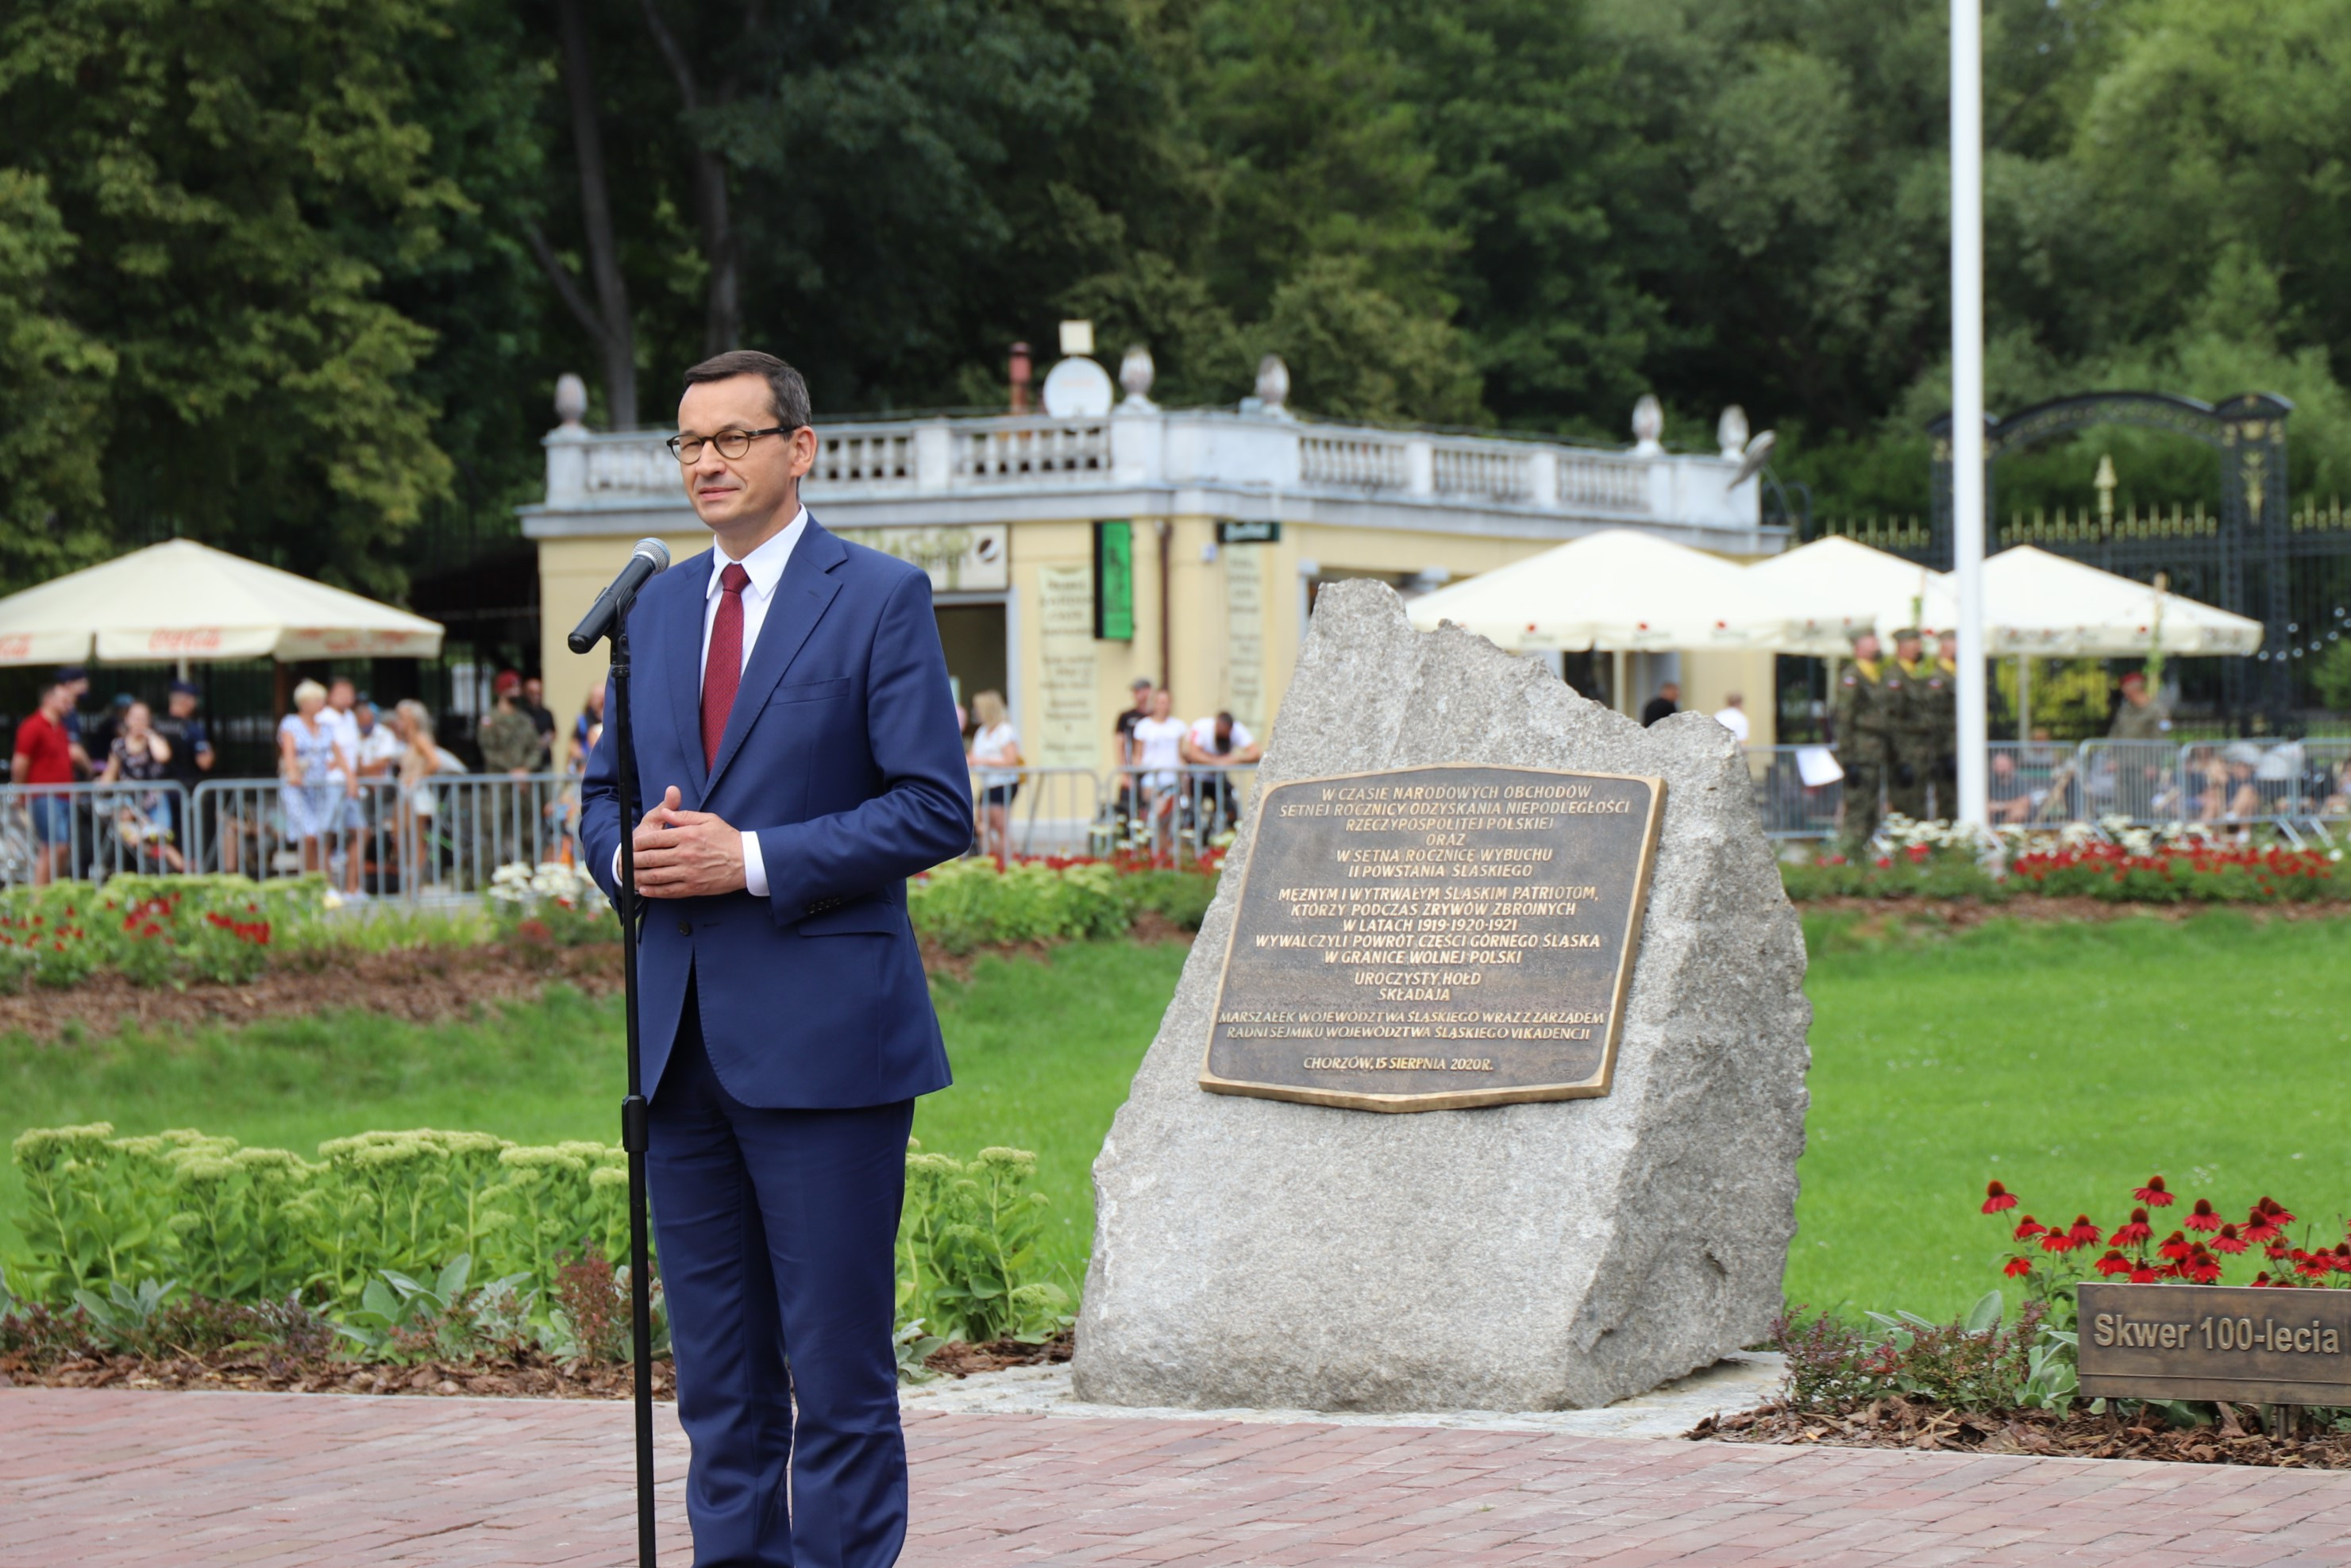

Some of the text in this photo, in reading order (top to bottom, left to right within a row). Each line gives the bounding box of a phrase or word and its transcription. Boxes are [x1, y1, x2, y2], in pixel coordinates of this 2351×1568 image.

[1322, 784, 1592, 801] W CZASIE NARODOWYCH OBCHODÓW
[1279, 799, 1630, 818] SETNEJ ROCZNICY ODZYSKANIA NIEPODLEGŁOŚCI
[1346, 817, 1554, 831] RZECZYPOSPOLITEJ POLSKIEJ
[1425, 833, 1466, 846] ORAZ
[1337, 849, 1350, 862] W
[1481, 848, 1553, 861] WYBUCHU
[1348, 865, 1359, 878] II
[1362, 865, 1445, 878] POWSTANIA
[1341, 888, 1347, 900] I
[1349, 887, 1440, 901] WYTRWAŁYM
[1512, 886, 1599, 902] PATRIOTOM,
[1291, 901, 1577, 916] KTÓRZY PODCZAS ZRYWÓW ZBROJNYCH
[1343, 919, 1355, 932] W
[1359, 919, 1413, 932] LATACH
[1256, 934, 1348, 948] WYWALCZYLI
[1352, 934, 1414, 948] POWRÓT
[1418, 934, 1466, 949] CZĘŚCI
[1470, 933, 1539, 948] GÓRNEGO
[1324, 950, 1523, 964] W GRANICE WOLNEJ POLSKI
[1355, 972, 1482, 985] UROCZYSTY HOŁD
[1219, 1011, 1295, 1023] MARSZAŁEK
[1298, 1011, 1405, 1023] WOJEWÓDZTWA
[1482, 1012, 1520, 1023] WRAZ
[1521, 1012, 1531, 1023] Z
[1227, 1027, 1268, 1038] RADNI
[1270, 1027, 1323, 1038] SEJMIKU
[1326, 1025, 1431, 1038] WOJEWÓDZTWA
[1375, 1058, 1387, 1069] 15
[1389, 1058, 1446, 1070] SIERPNIA
[2094, 1314, 2340, 1354] Skwer 100-lecia
